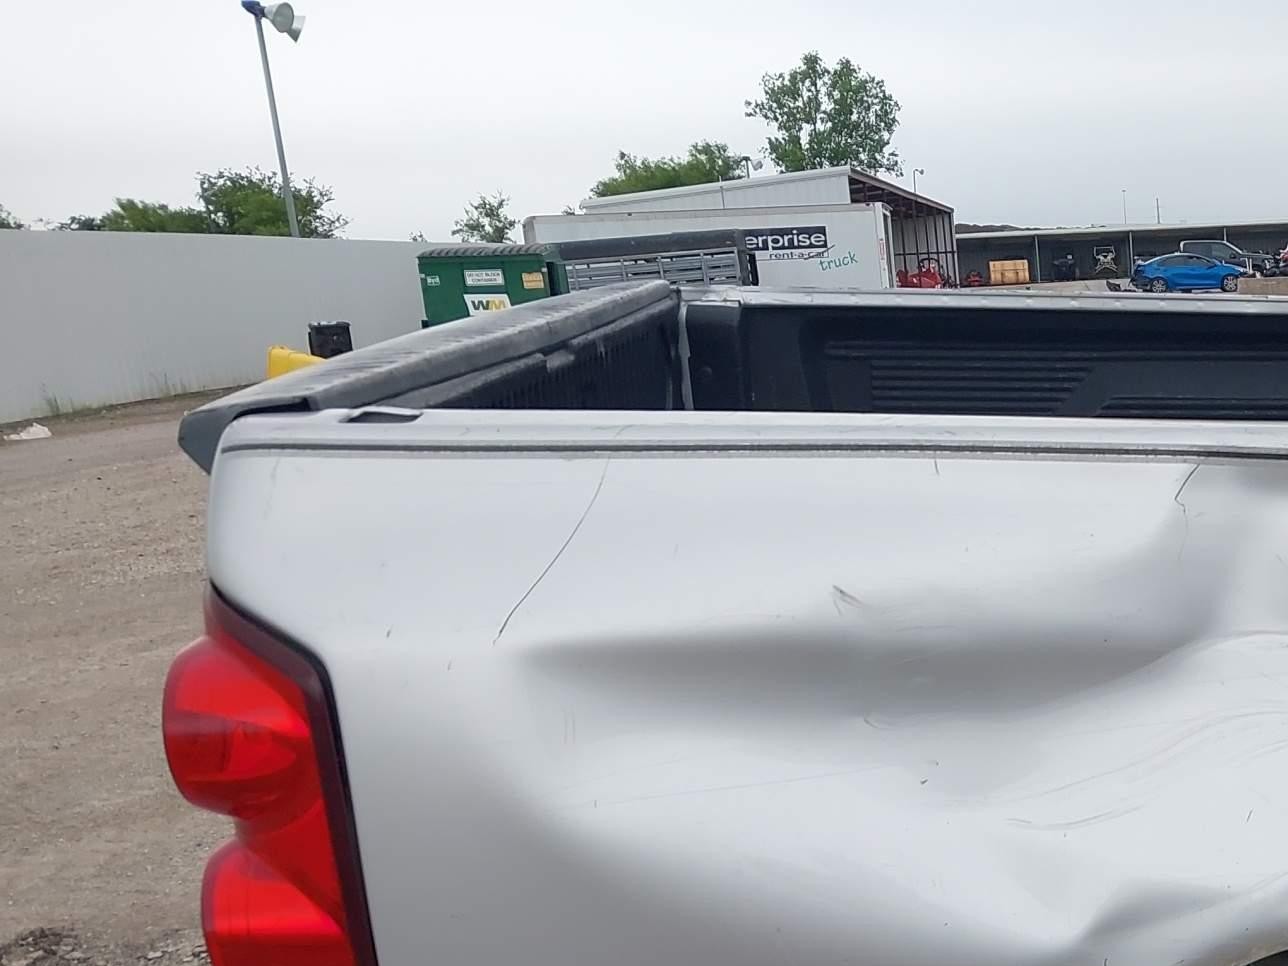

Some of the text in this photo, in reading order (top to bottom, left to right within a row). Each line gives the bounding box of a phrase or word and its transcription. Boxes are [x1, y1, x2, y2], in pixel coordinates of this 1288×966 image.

[745, 229, 825, 251] erprise
[818, 251, 859, 271] truck
[470, 299, 506, 311] WM
